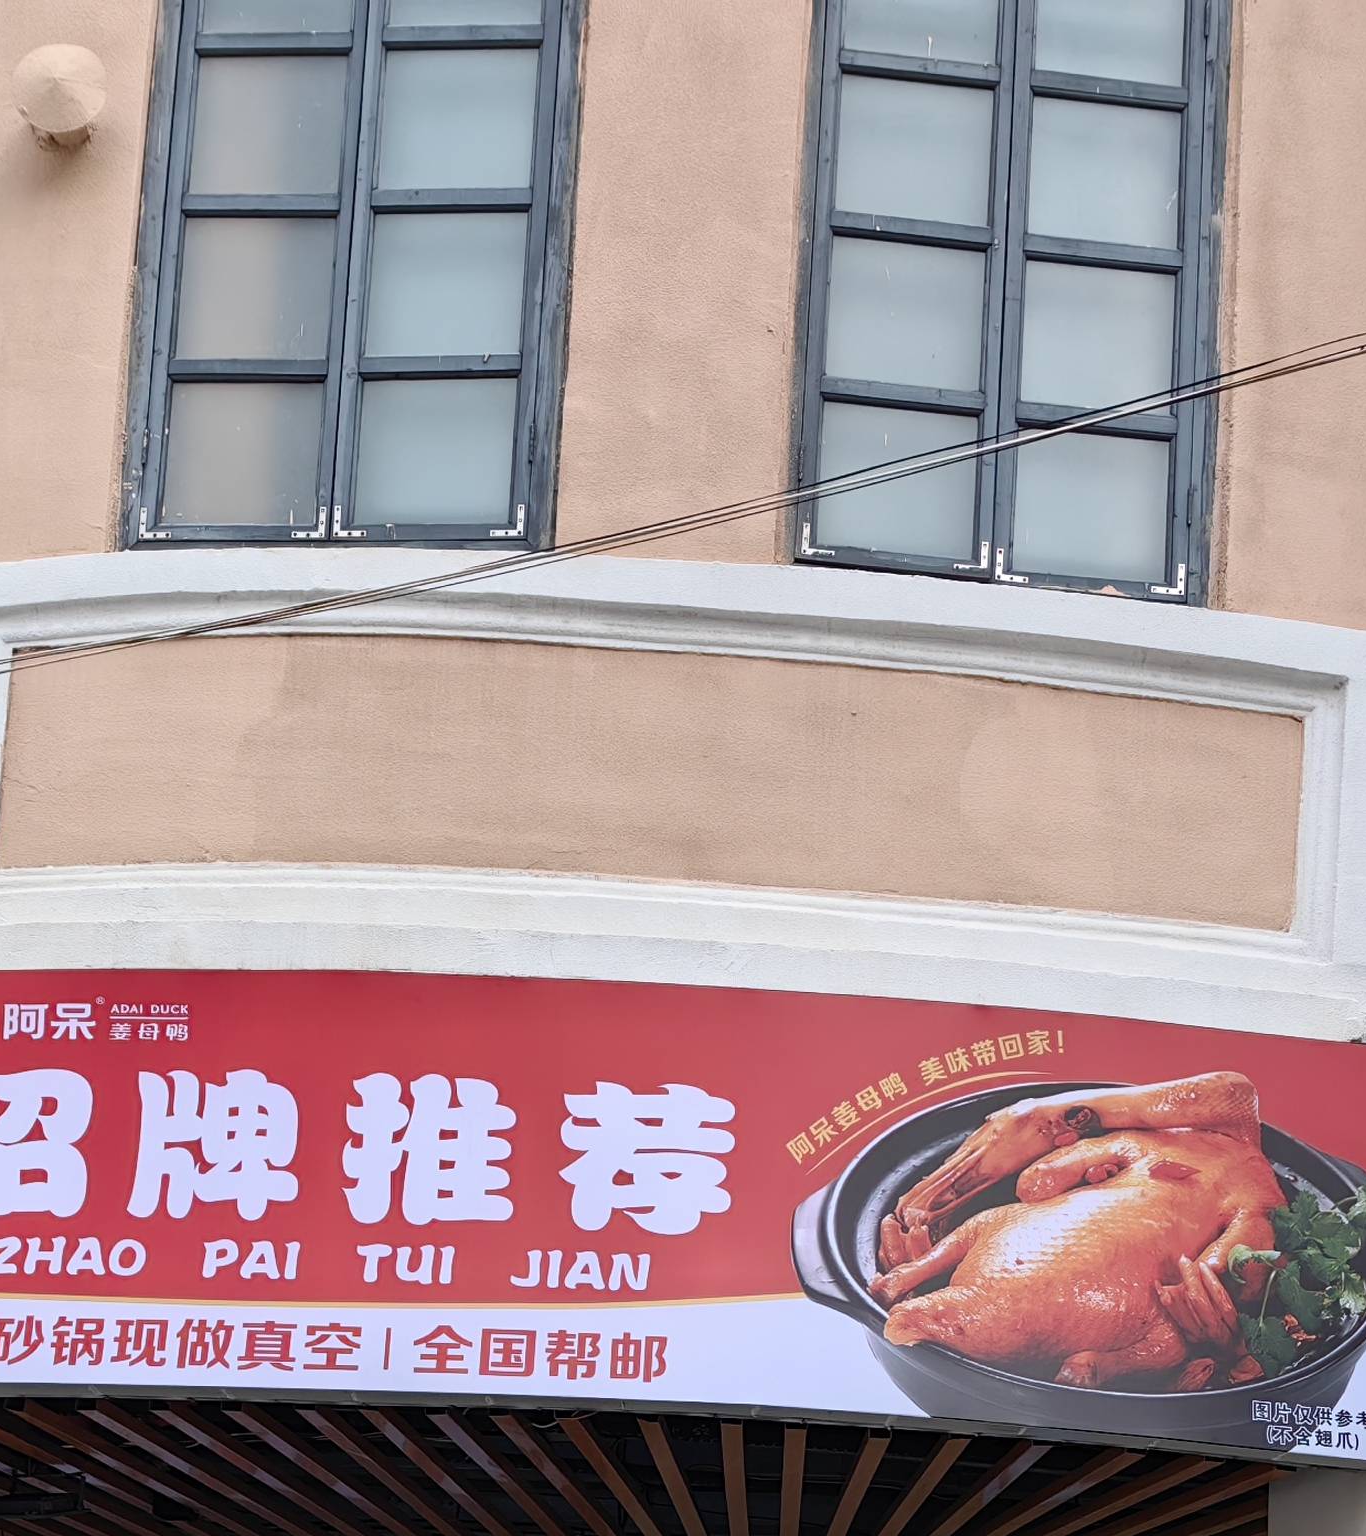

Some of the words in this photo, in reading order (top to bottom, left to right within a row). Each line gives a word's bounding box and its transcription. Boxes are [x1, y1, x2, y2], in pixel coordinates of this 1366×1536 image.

[3, 1002, 96, 1041] 阿呆
[109, 1022, 189, 1041] 姜母鸭
[110, 1004, 143, 1014] ADAI
[151, 1004, 189, 1015] DUCK
[786, 1072, 910, 1165] 阿呆姜母鸭
[202, 1240, 301, 1280] PAI
[357, 1244, 454, 1284] TUI
[510, 1250, 653, 1291] JIAN
[412, 1324, 669, 1385] 全国帮邮
